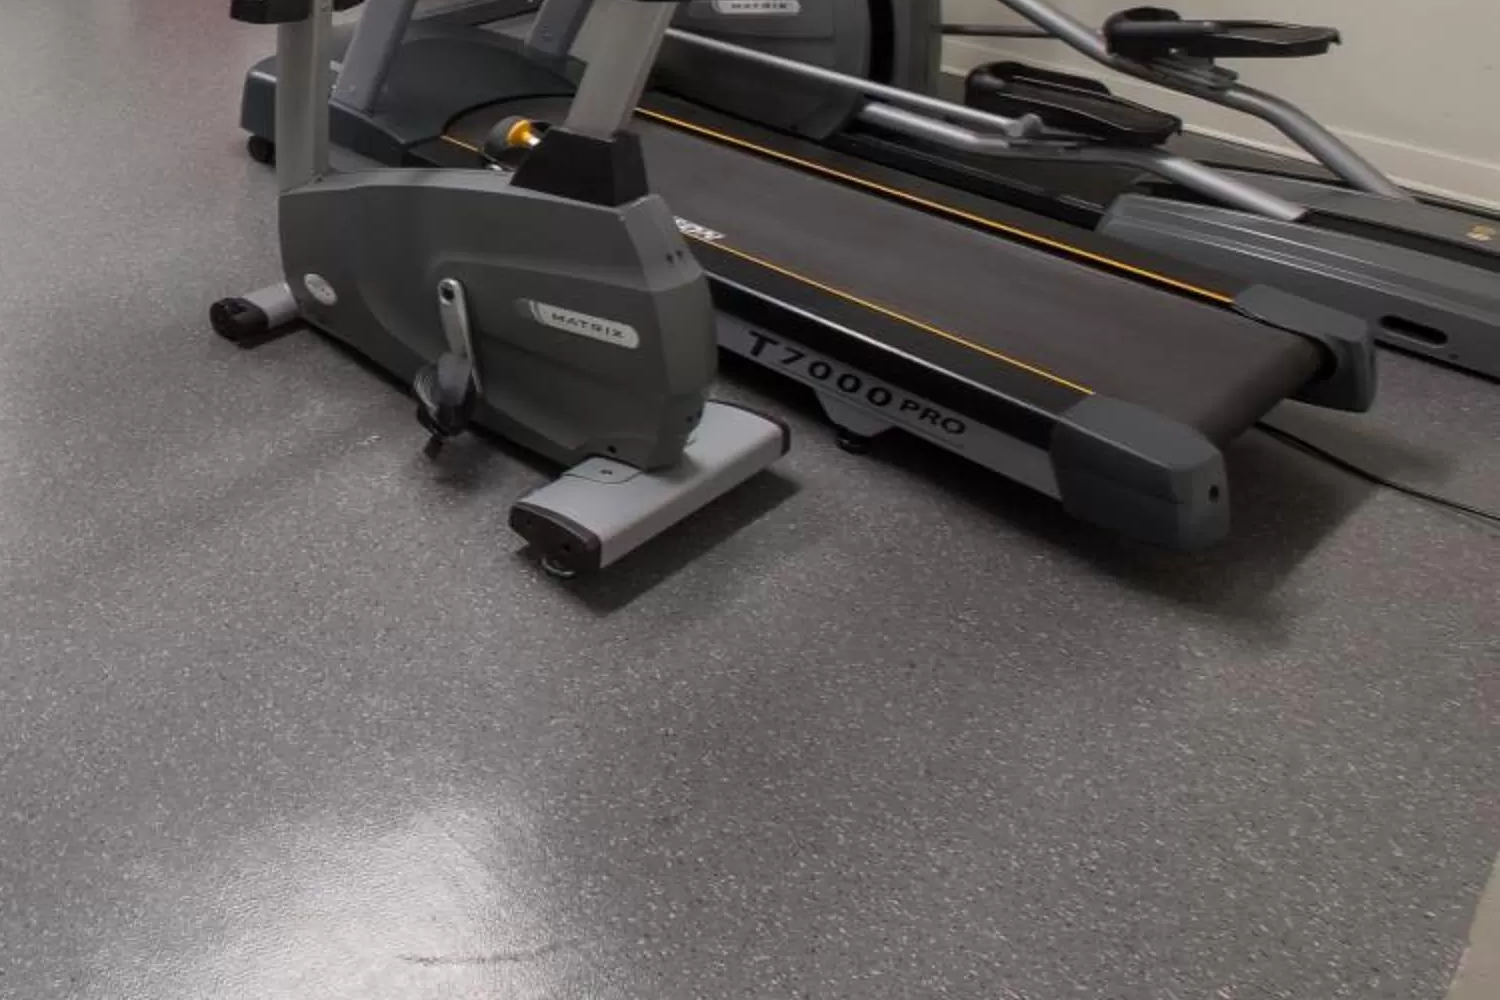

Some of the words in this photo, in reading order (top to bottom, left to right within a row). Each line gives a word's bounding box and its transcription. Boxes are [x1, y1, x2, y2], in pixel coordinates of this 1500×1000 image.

[551, 312, 626, 339] MATRIX
[748, 331, 893, 407] T7000
[900, 399, 967, 435] PRO
